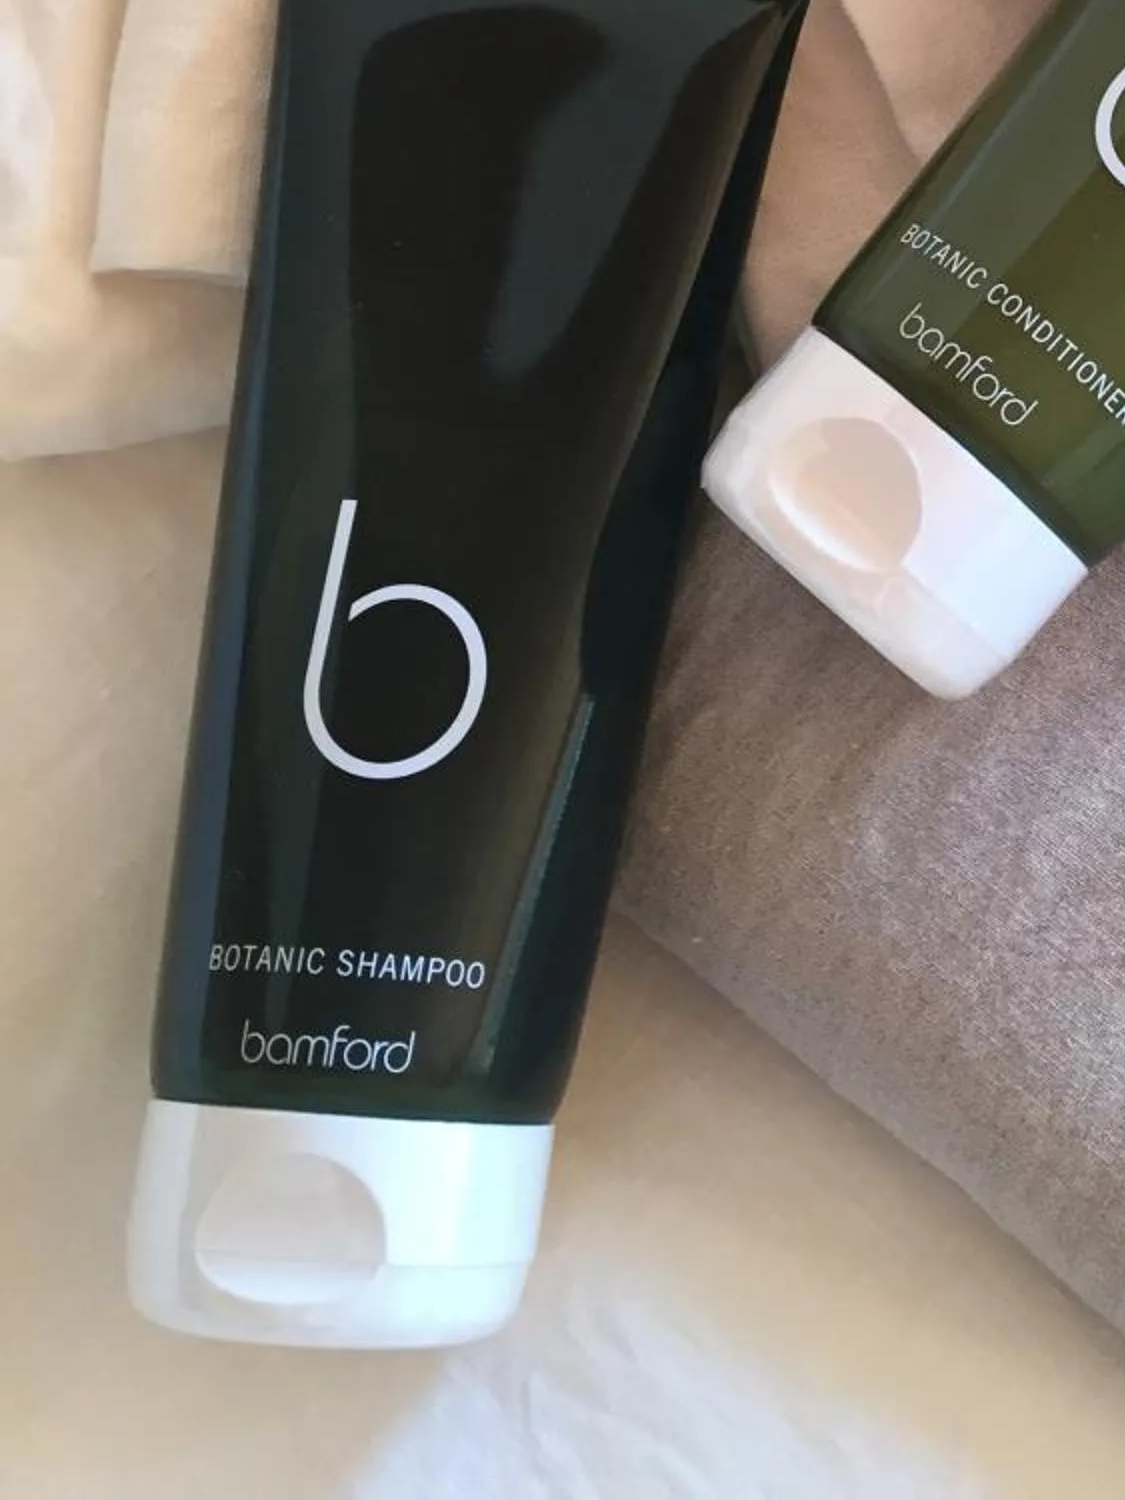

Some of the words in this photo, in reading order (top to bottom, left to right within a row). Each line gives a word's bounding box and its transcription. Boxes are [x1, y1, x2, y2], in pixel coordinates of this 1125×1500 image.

[900, 224, 988, 290] BOTANIC
[899, 303, 1039, 426] bamford
[303, 499, 487, 779] b
[208, 943, 326, 976] BOTANIC
[336, 949, 485, 990] SHAMPOO
[241, 1019, 416, 1074] bamford
